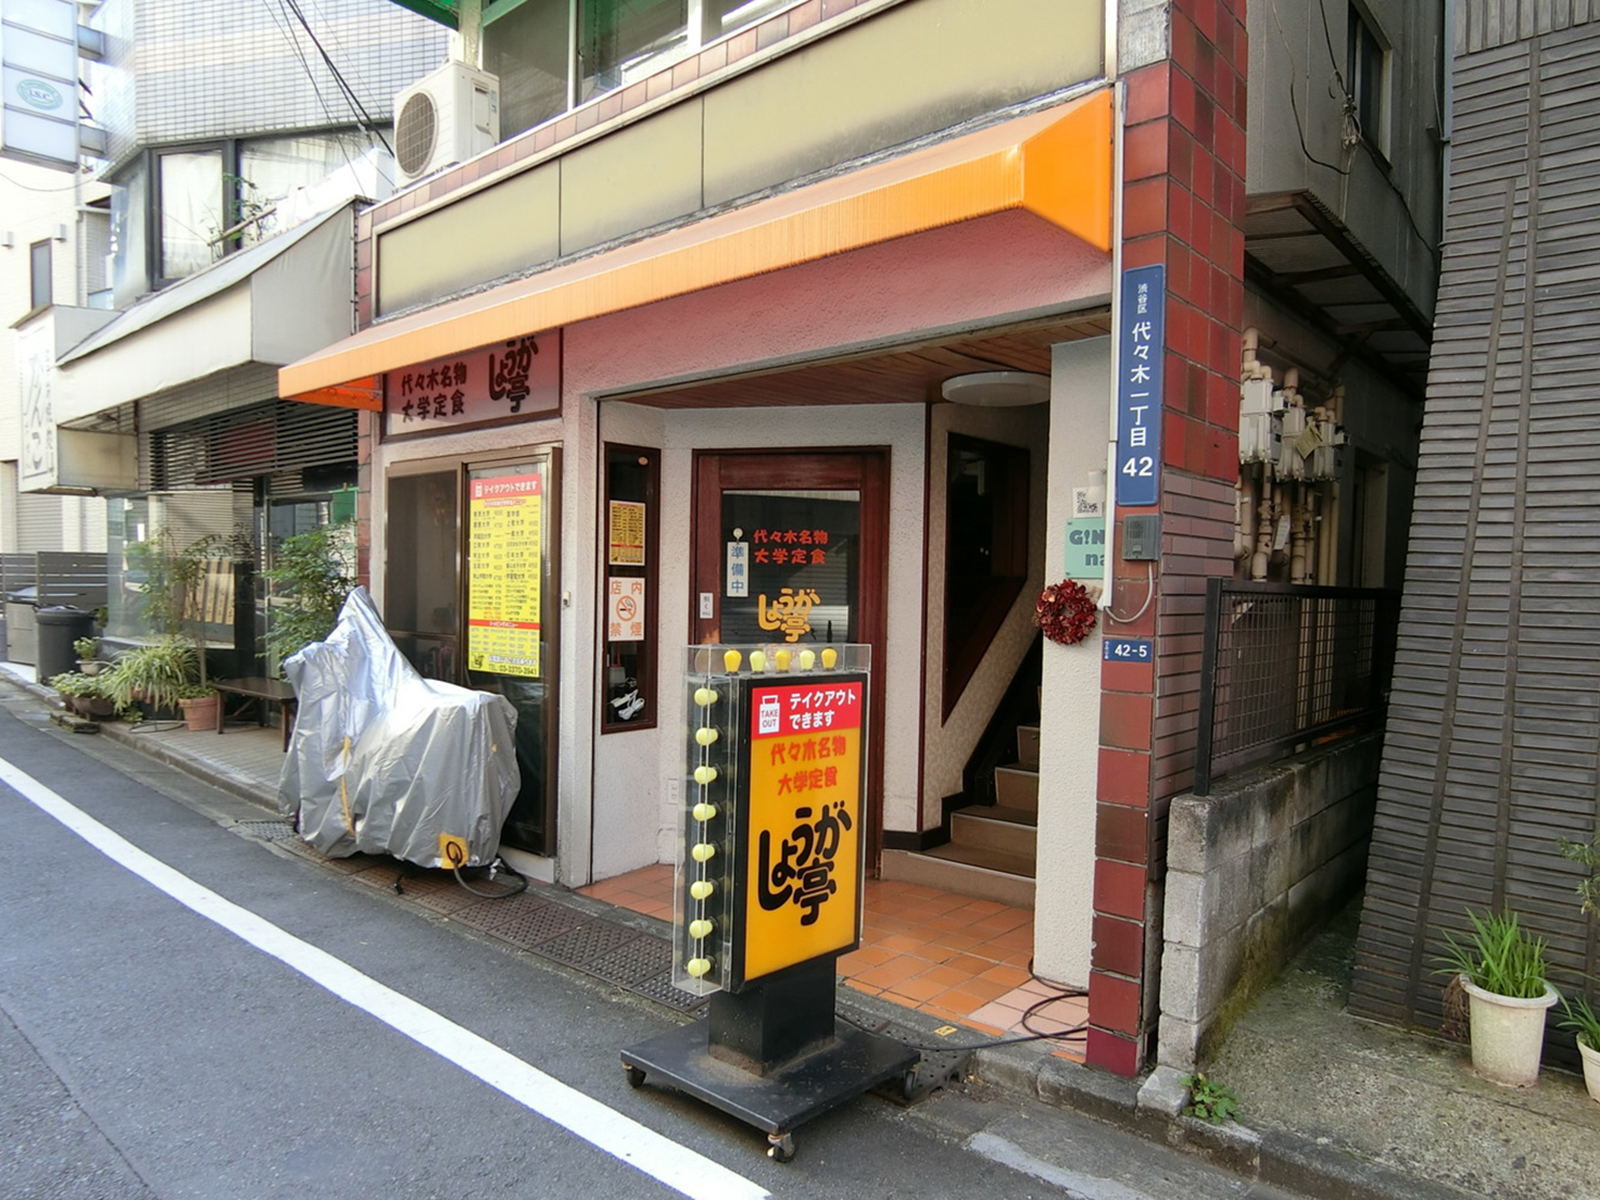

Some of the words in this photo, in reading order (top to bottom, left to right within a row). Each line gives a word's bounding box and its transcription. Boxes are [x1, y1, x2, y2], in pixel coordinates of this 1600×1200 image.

[1137, 283, 1148, 314] 渋谷区
[401, 361, 467, 397] 代々木名物
[1130, 321, 1151, 448] 代々木一丁目
[402, 389, 466, 423] 大学定食
[1122, 456, 1154, 477] 42
[484, 480, 537, 494] テイクアウトできます
[753, 529, 828, 545] 代々木名物
[754, 548, 827, 565] 大学定食
[731, 545, 744, 593] 準備中
[1114, 643, 1148, 658] 42-5
[789, 688, 856, 711] テイクアウト
[761, 709, 779, 719] TAKE
[762, 719, 777, 728] OUT
[789, 709, 835, 730] できます
[770, 735, 846, 766] 代々木名物
[778, 766, 838, 796] 大学定食
